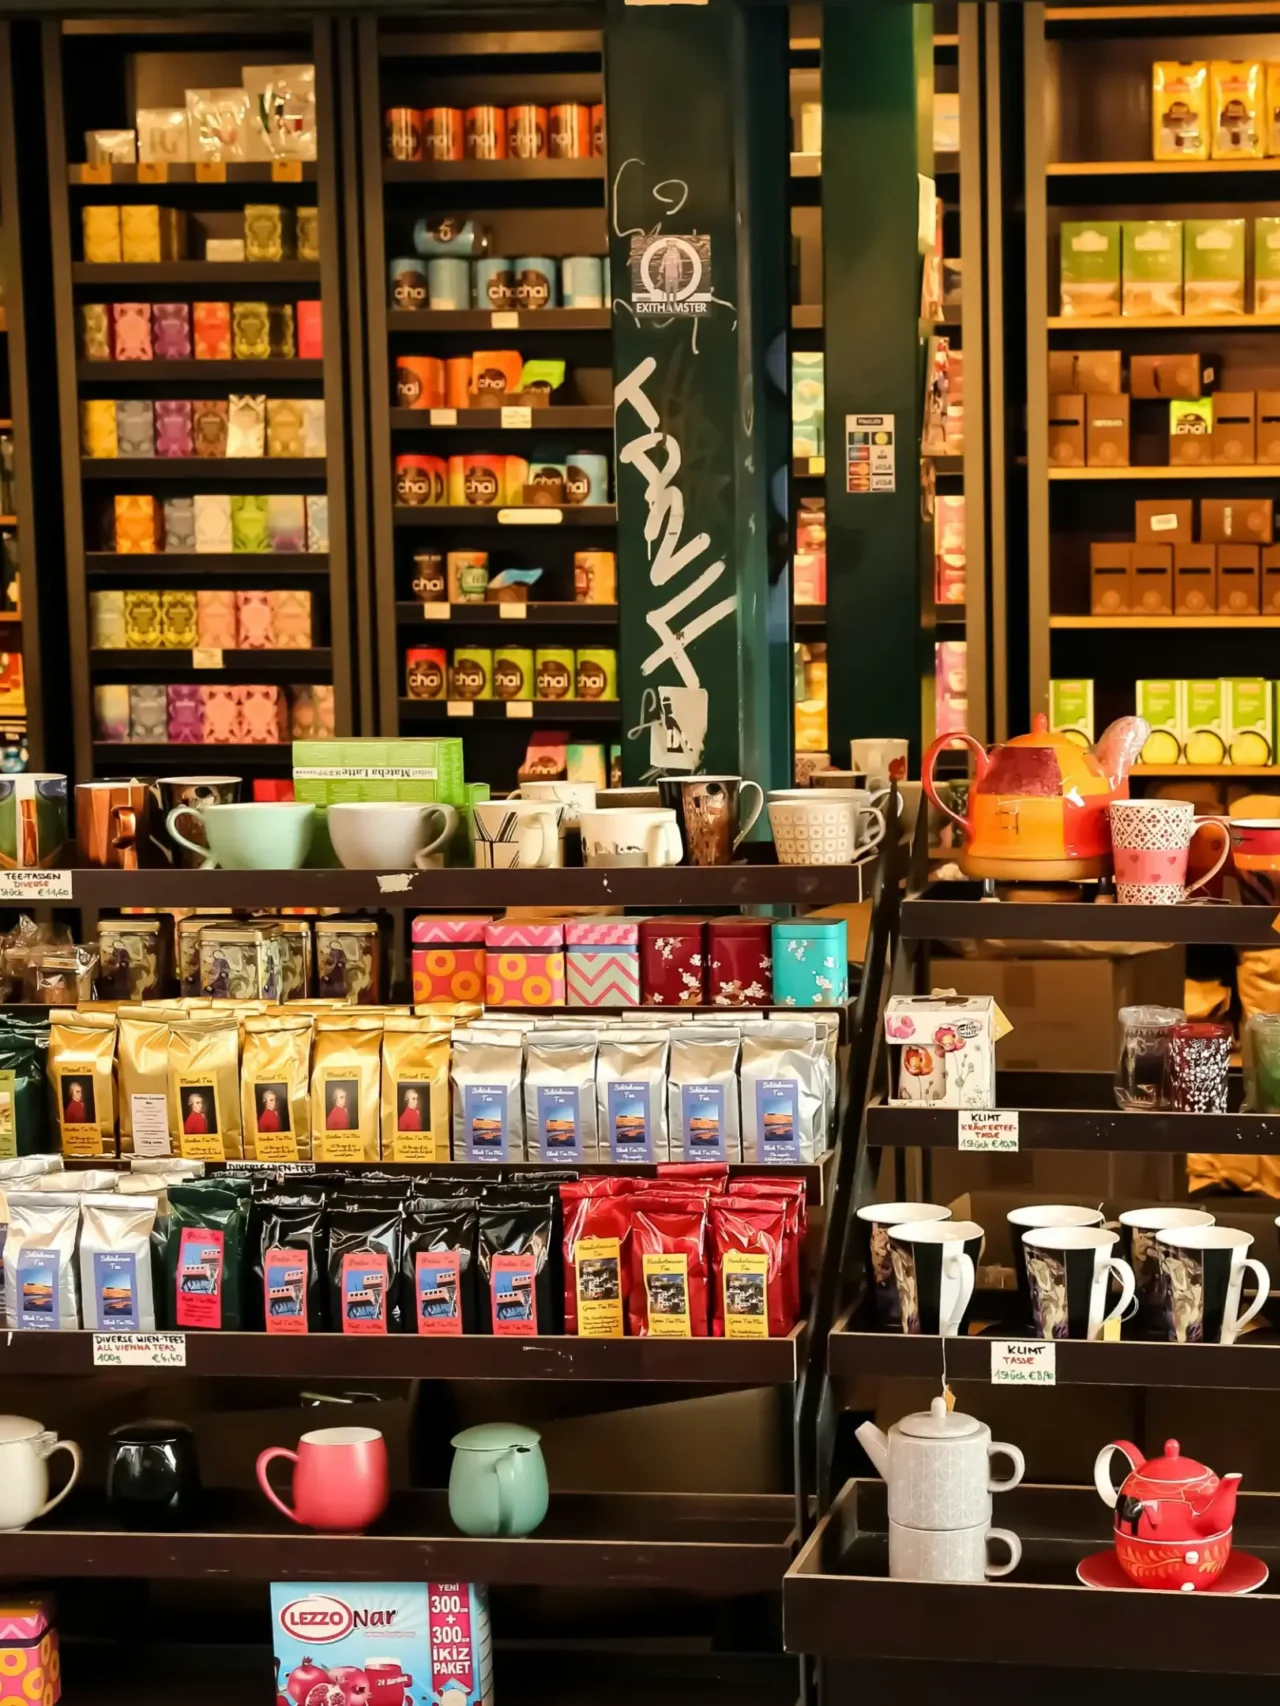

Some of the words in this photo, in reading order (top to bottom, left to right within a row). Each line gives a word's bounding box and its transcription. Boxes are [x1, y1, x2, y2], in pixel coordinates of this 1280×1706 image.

[342, 768, 369, 778] Latte
[371, 768, 411, 778] Matcha
[971, 1113, 1002, 1121] KLIMT
[95, 1336, 132, 1344] DIVERSE
[136, 1336, 184, 1344] WIEN-TEES
[1008, 1345, 1046, 1355] KLIMT
[97, 1353, 121, 1363] 100g
[438, 1583, 459, 1591] YENİ
[290, 1611, 343, 1626] LEZZO
[353, 1609, 396, 1628] Nar
[433, 1645, 470, 1660] İKİZ
[434, 1661, 470, 1674] PAKET
